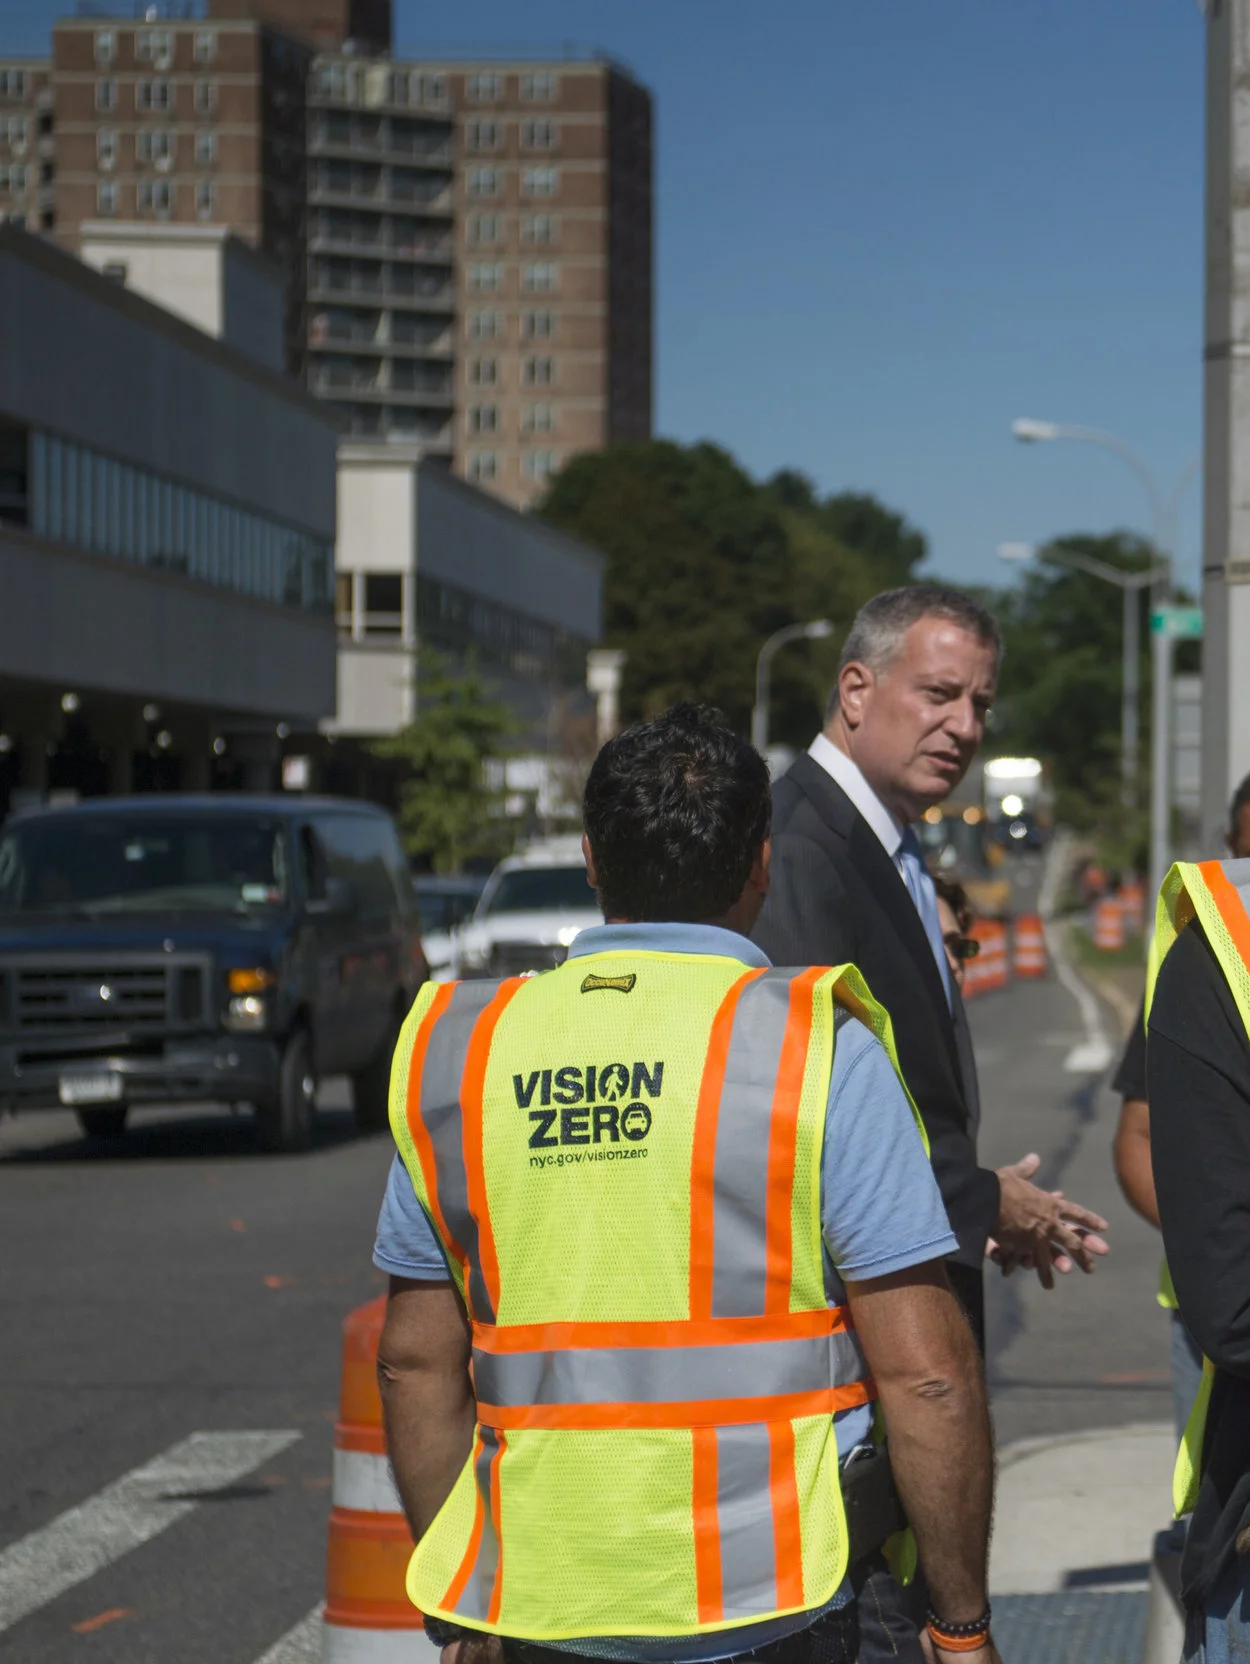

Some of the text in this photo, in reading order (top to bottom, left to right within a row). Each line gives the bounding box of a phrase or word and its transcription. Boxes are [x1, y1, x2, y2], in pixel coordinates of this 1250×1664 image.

[512, 1061, 664, 1109] VISION
[528, 1102, 652, 1149] ZERO
[529, 1148, 648, 1168] nyc.gov/visionzero
